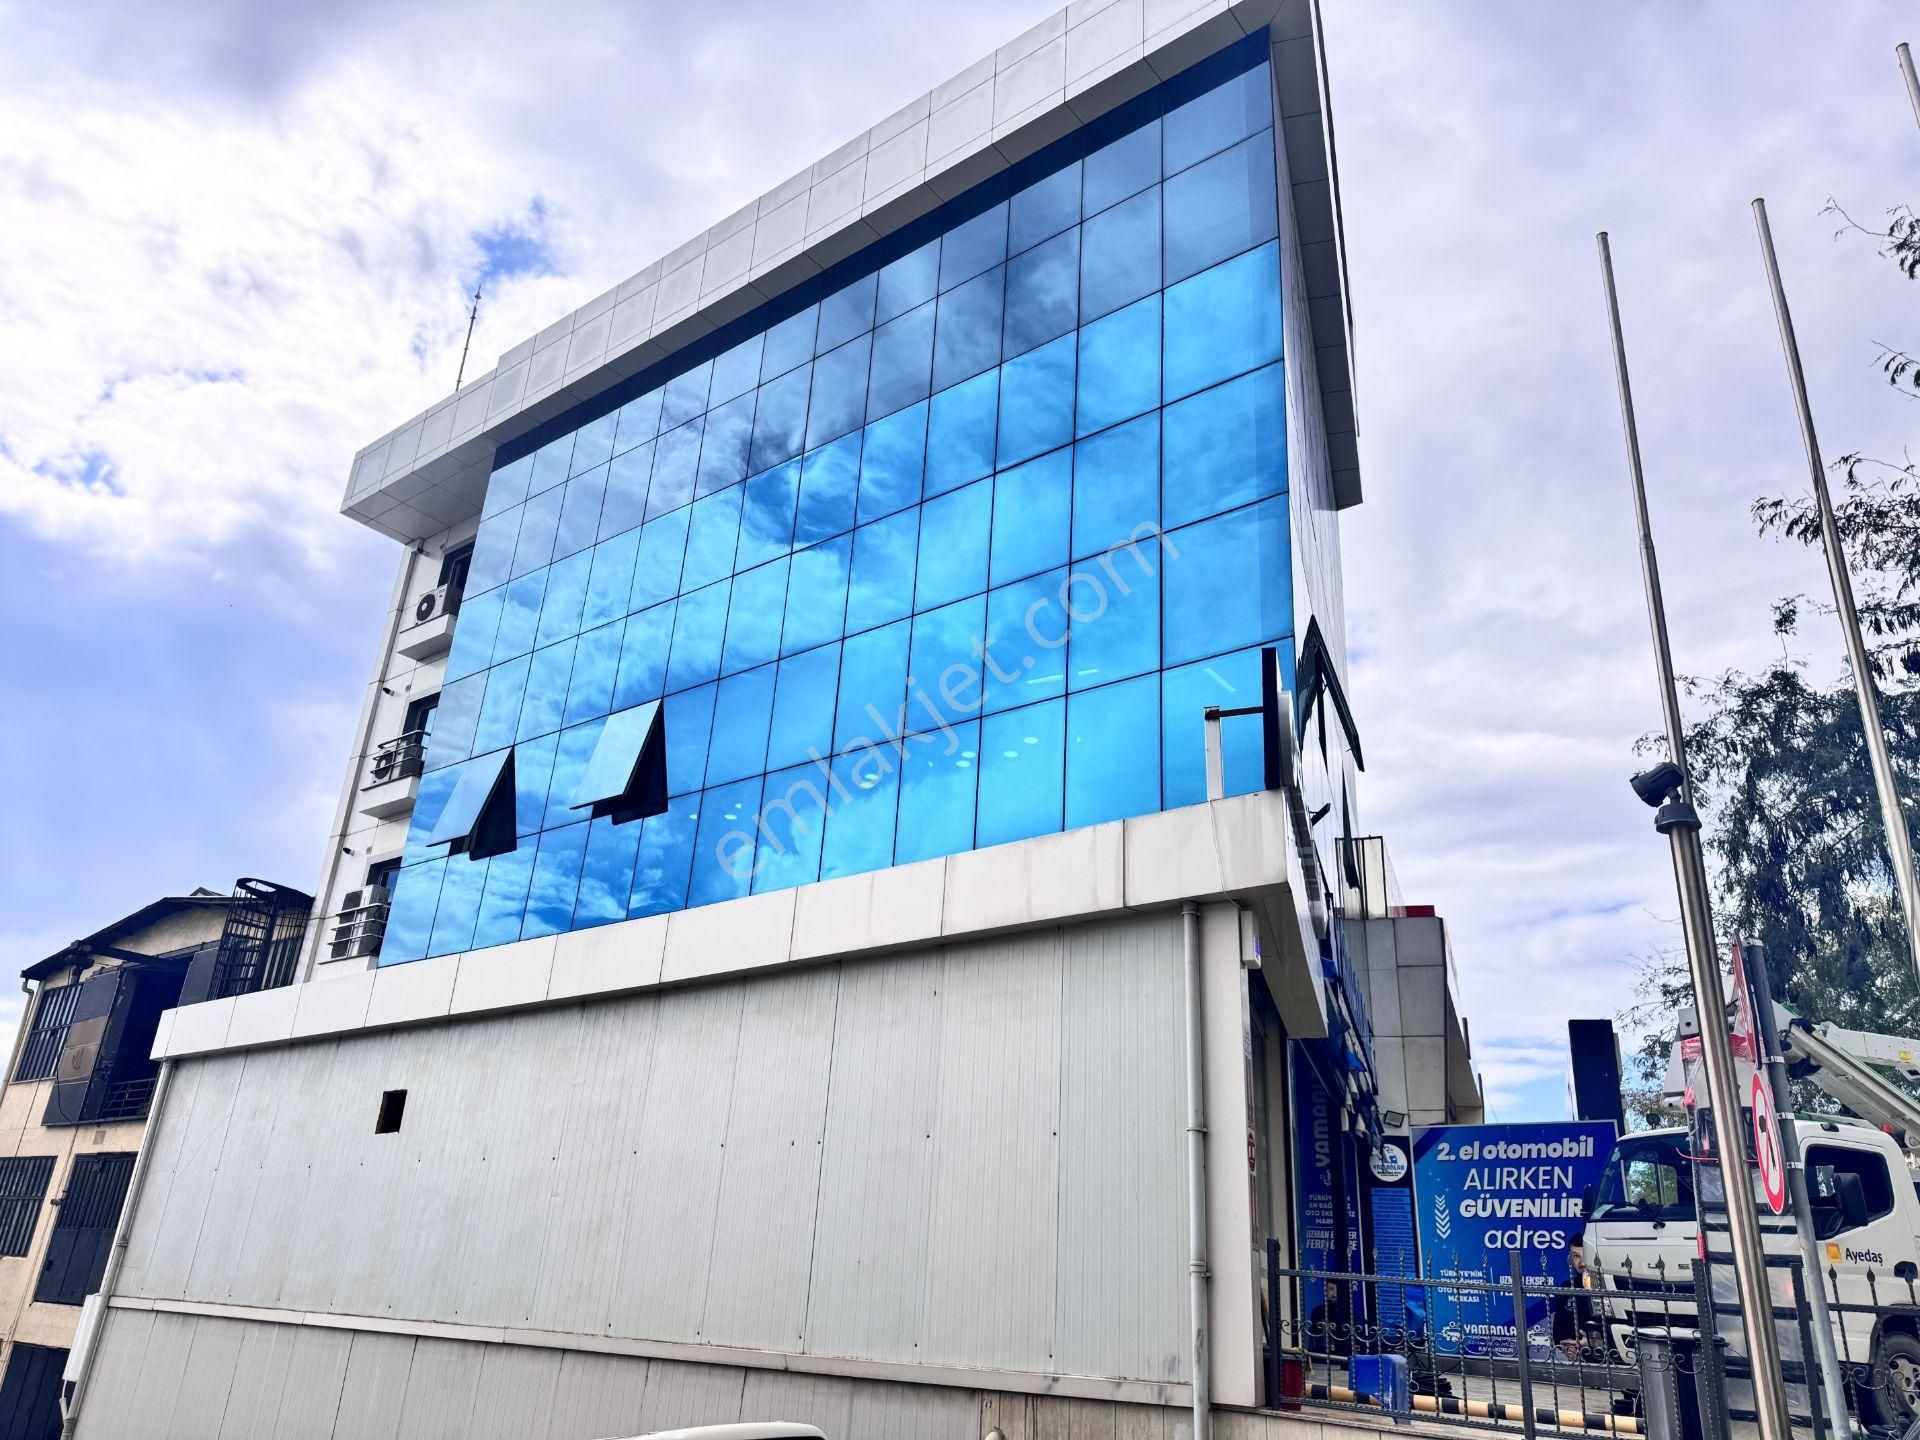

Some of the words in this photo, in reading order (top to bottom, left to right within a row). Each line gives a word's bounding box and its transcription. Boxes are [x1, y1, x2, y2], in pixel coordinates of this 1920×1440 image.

[1436, 1142, 1456, 1161] 2.
[1459, 1141, 1480, 1160] el
[1483, 1135, 1594, 1160] otomobil
[1463, 1166, 1573, 1191] ALIRKEN
[1459, 1192, 1584, 1219] GÜVENİLİR
[1484, 1225, 1566, 1250] adres
[1845, 1247, 1884, 1267] Ayedaş
[1463, 1324, 1518, 1336] YAMANLA
